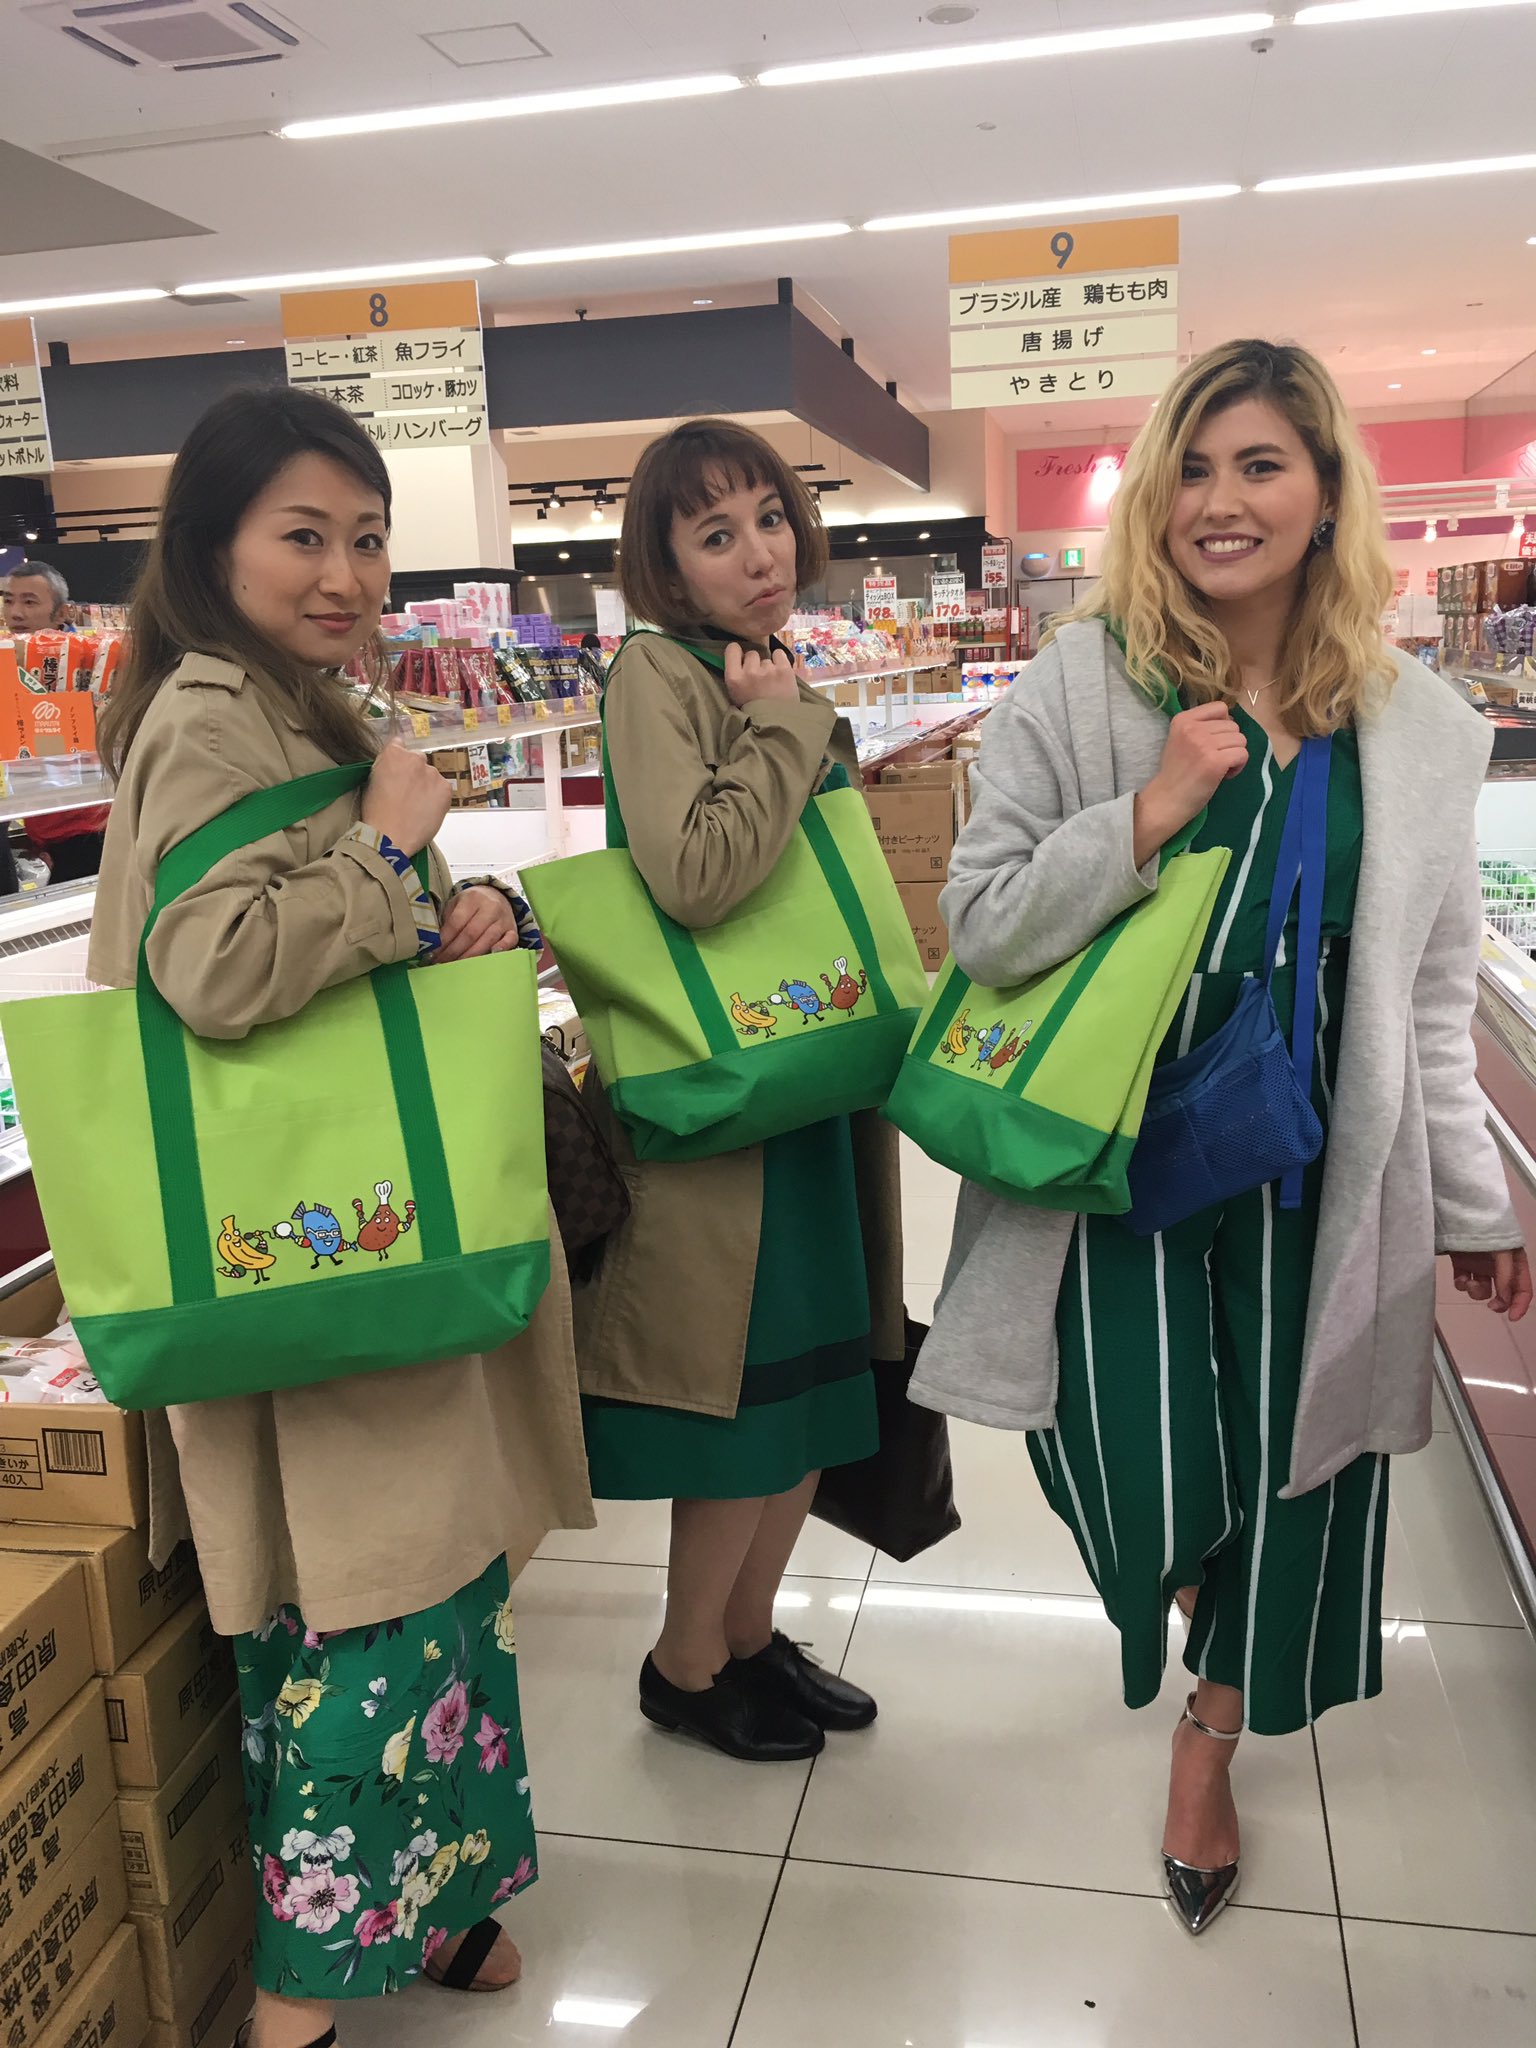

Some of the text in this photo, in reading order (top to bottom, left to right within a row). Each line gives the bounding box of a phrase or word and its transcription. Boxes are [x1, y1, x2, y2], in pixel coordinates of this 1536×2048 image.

[1050, 232, 1074, 269] 9
[959, 278, 1168, 315] ブラジル産 鶏もも肉
[369, 293, 388, 327] 8
[1021, 325, 1104, 352] 唐揚げ
[291, 346, 378, 367] コーヒー・紅茶
[395, 339, 466, 362] 魚フライ
[391, 379, 477, 400] コロッケ・豚カツ
[1010, 369, 1114, 396] やきとり
[362, 424, 386, 441] トル
[393, 417, 482, 440] ハンバーグ
[1035, 454, 1099, 476] Fresh
[868, 607, 891, 619] 198
[936, 604, 960, 618] 170
[877, 834, 940, 845] 付きピーナッツ
